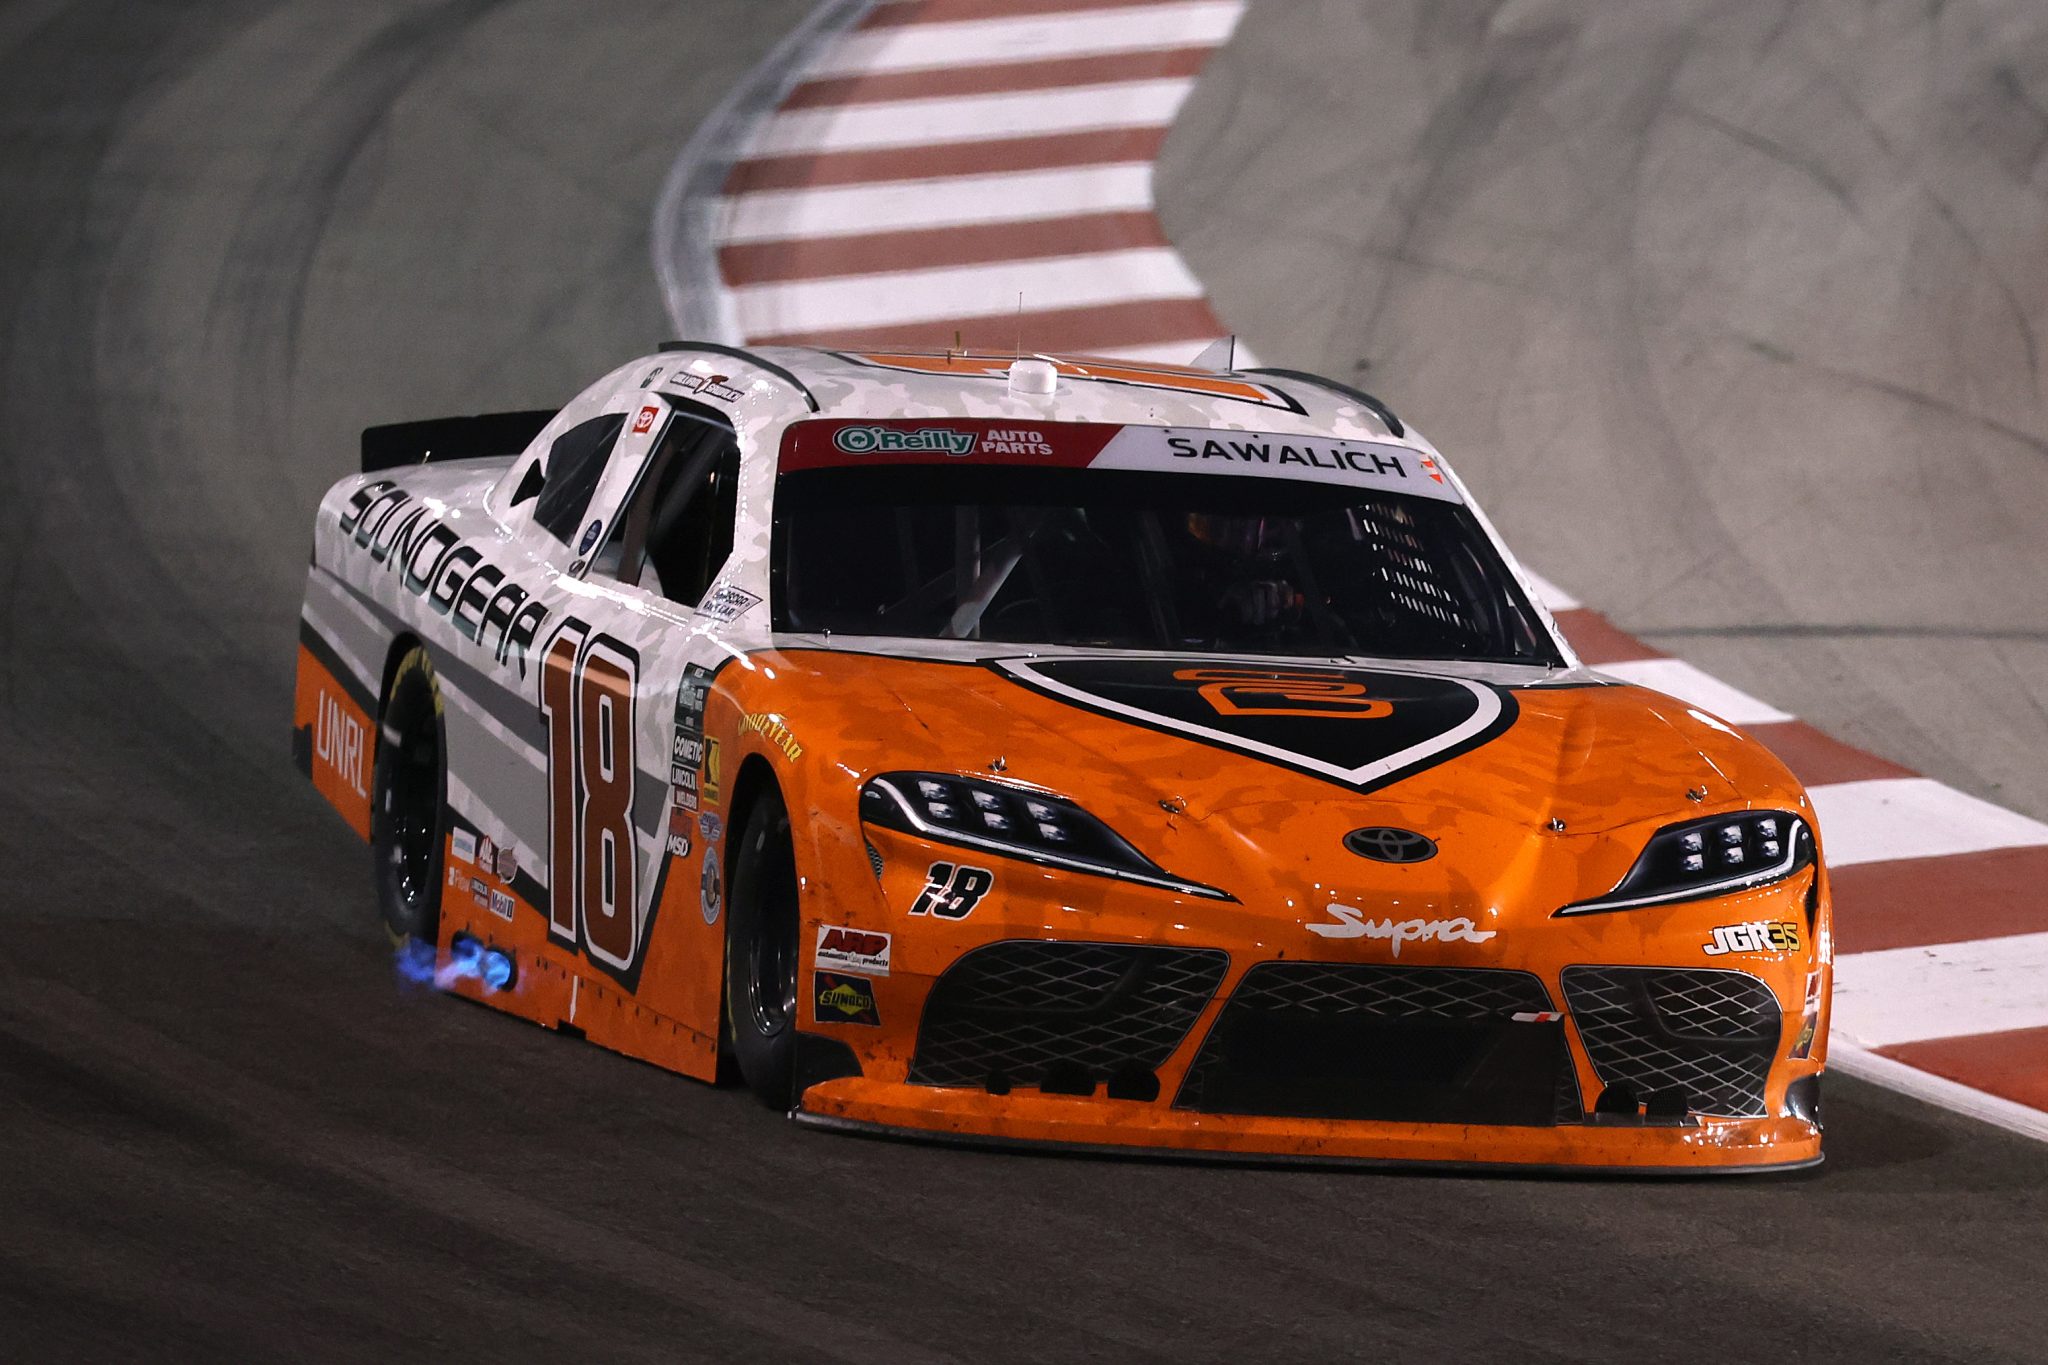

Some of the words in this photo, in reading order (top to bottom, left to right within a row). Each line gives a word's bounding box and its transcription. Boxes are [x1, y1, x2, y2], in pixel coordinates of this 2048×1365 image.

[840, 427, 975, 455] O'Reilly
[981, 441, 1054, 456] PARTS
[987, 429, 1044, 443] AUTO
[1167, 437, 1408, 478] SAWALICH
[339, 479, 552, 681] SOUNDGEAR
[317, 688, 367, 799] UNRL
[538, 616, 641, 974] 18
[667, 834, 689, 857] MSD
[908, 861, 993, 921] 18
[1305, 903, 1497, 959] Supra
[820, 990, 873, 1010] SUNOCO
